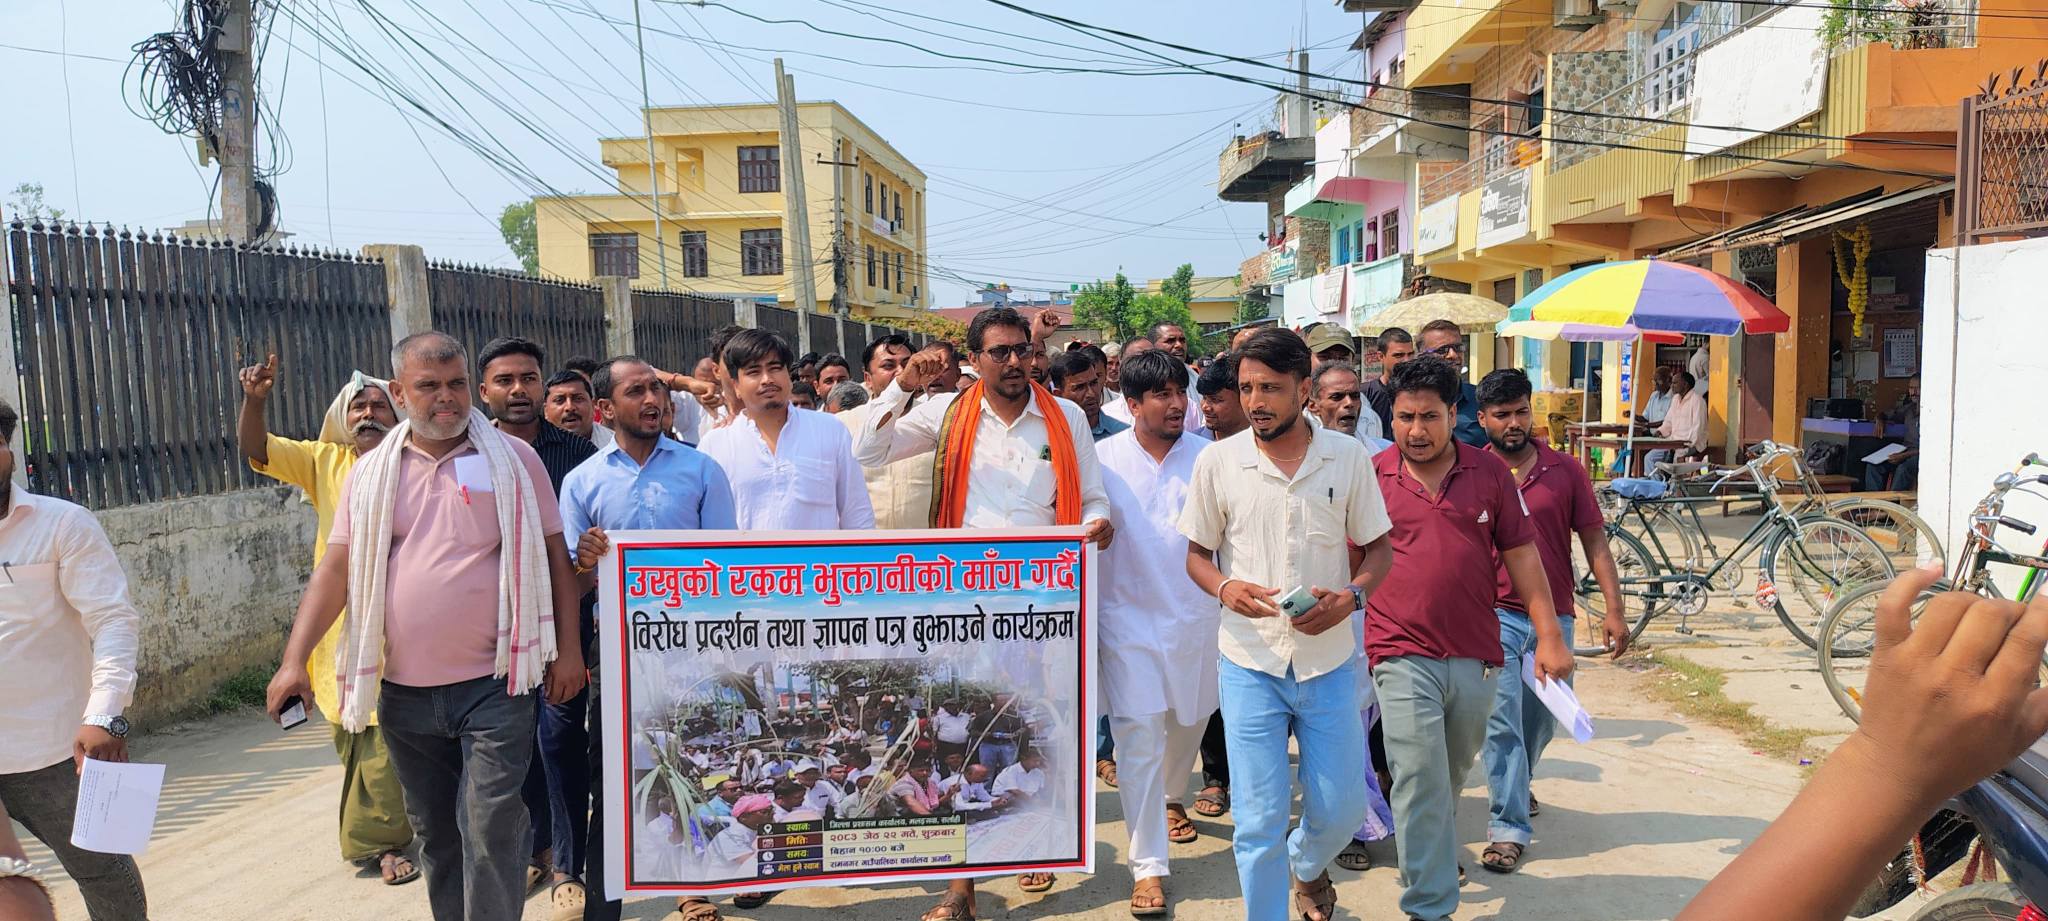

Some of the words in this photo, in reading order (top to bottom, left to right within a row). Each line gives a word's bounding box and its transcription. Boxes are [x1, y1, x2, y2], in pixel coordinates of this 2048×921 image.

[629, 559, 721, 608] उखुको
[729, 564, 806, 597] रकम
[813, 554, 955, 606] भुक्तानीको
[962, 549, 1024, 591] माँग
[1030, 548, 1078, 591] गर्दै
[632, 611, 688, 651] विरोध
[695, 611, 760, 652] प्रदर्शन
[767, 618, 805, 650] तथा
[812, 616, 868, 650] ज्ञापन
[875, 615, 906, 646] पत्र
[913, 604, 986, 654] बुझाउने
[992, 604, 1075, 642] कार्यक्रम
[830, 833, 858, 842] २०८३
[863, 830, 880, 840] जेठ
[883, 831, 897, 839] २२
[921, 828, 956, 841] शुक्रबार
[830, 846, 856, 856] बिहान
[890, 843, 905, 852] बजे
